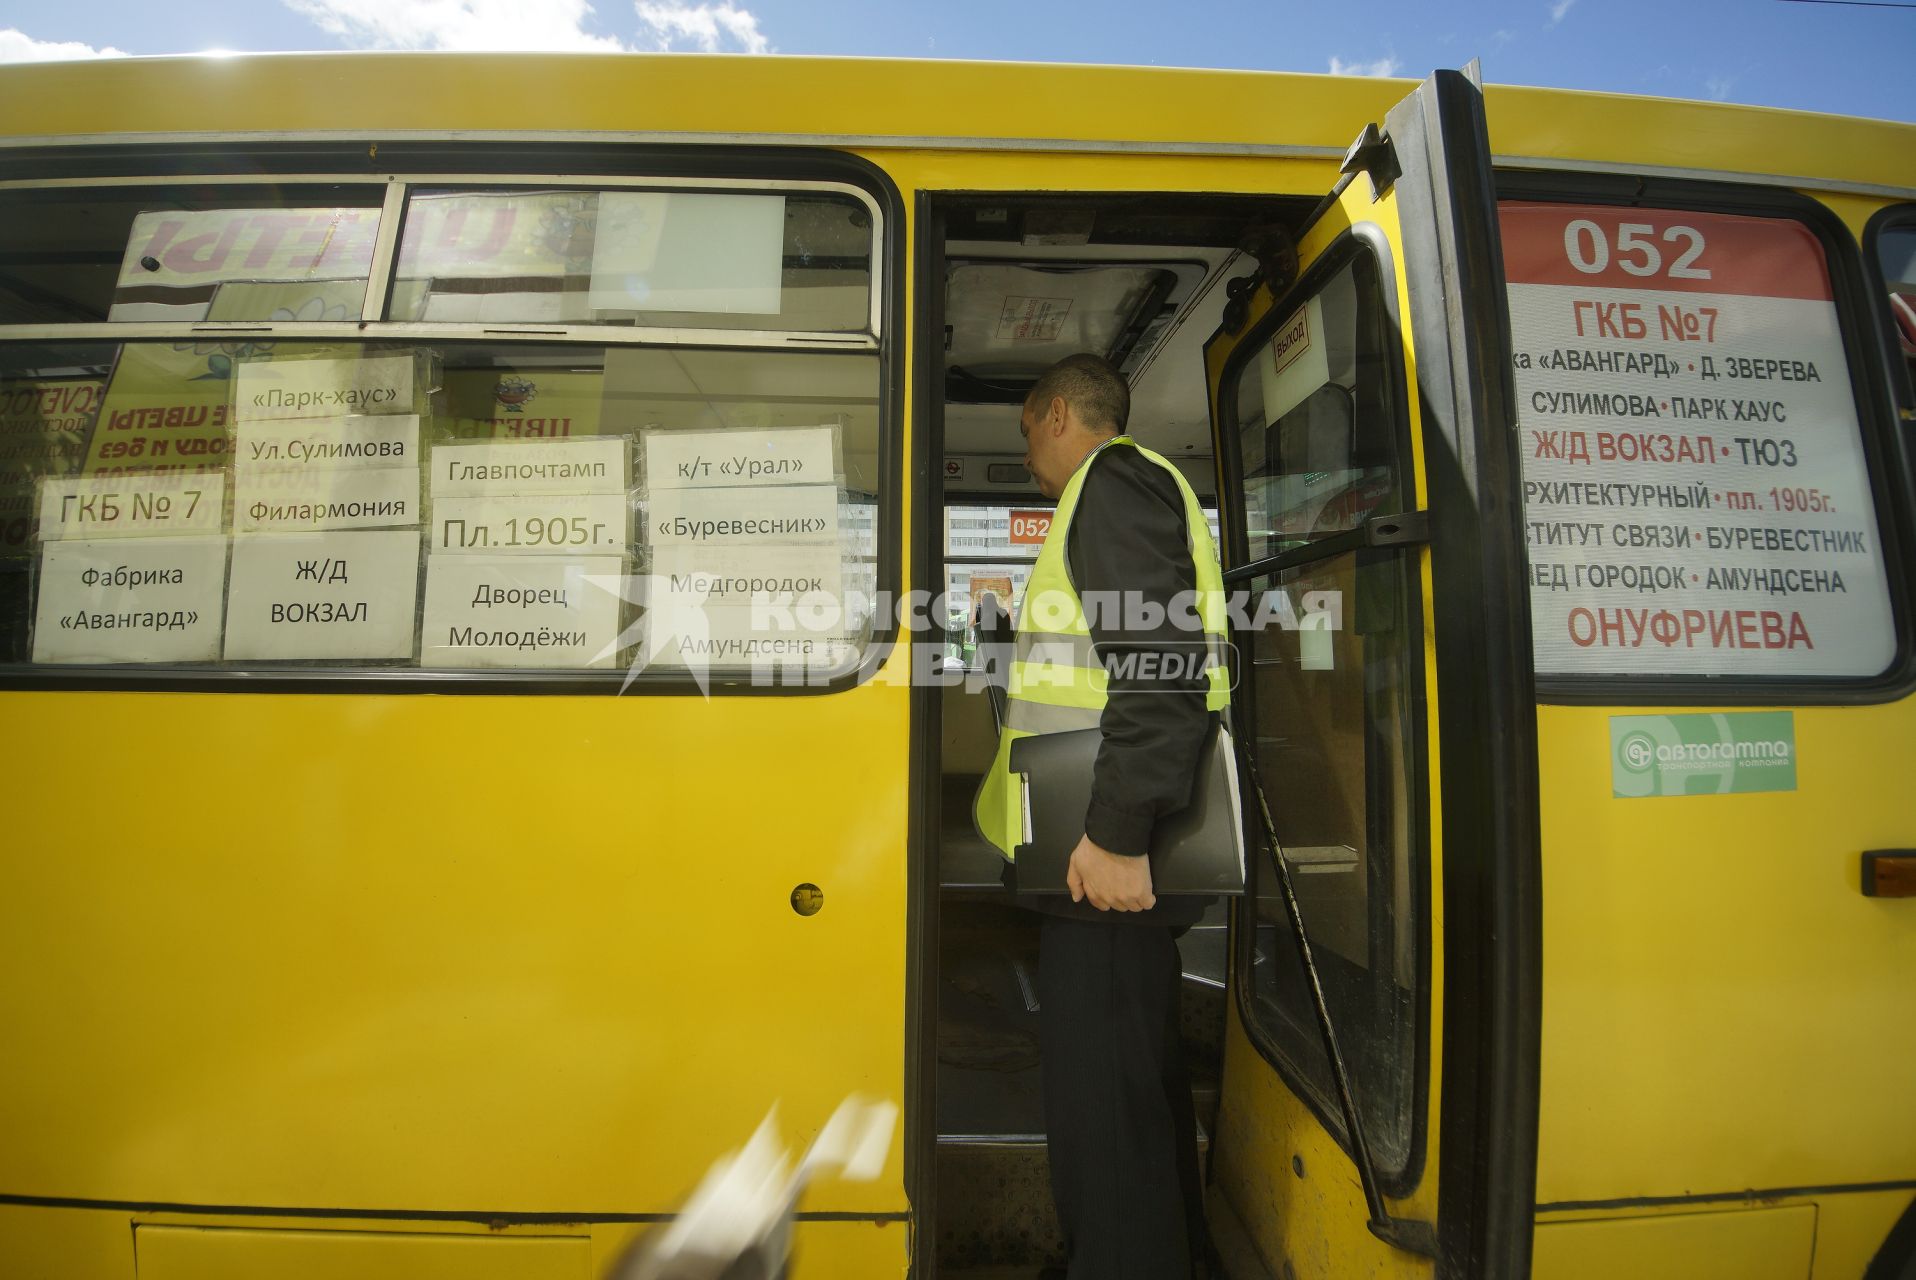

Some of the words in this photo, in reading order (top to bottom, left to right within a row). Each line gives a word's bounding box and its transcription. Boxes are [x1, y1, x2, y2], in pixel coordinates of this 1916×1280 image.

[1563, 219, 1712, 280] 052
[1572, 300, 1647, 339] ГКБ
[1658, 304, 1719, 344] №7
[1277, 321, 1305, 358] ВЫХОД
[1539, 349, 1680, 377] «АВАНГАРД»
[1701, 356, 1721, 381] Д.
[1727, 357, 1822, 383] ЗВЕРЕВА
[253, 387, 397, 409] «Парк-хаус»
[1532, 391, 1660, 418] СУЛИМОВА
[1672, 396, 1728, 421] ПАРК
[1734, 400, 1786, 423] ХАУС
[250, 439, 404, 462] Ул.Сулимова
[1532, 430, 1590, 465] Ж/Д
[1599, 432, 1717, 465] ВОКЗАЛ
[1734, 437, 1798, 466] ТЮЗ
[449, 459, 606, 481] Главпочтамп
[677, 455, 713, 478] к/т
[719, 455, 803, 478] «Урал»
[61, 494, 119, 522] ГКБ
[132, 492, 170, 520] №
[184, 491, 201, 519] 7
[249, 499, 405, 522] Филармония
[1727, 491, 1764, 511] пл.
[1770, 487, 1837, 513] 1905г.
[443, 517, 615, 548] Пл.1905г.
[658, 515, 826, 540] «Буревесник»
[1013, 518, 1050, 538] 052
[1612, 524, 1691, 548] СВЯЗИ
[1706, 527, 1867, 553] БУРЕВЕСТНИК
[81, 566, 183, 591] Фабрика
[295, 559, 347, 585] Ж/Д
[1575, 564, 1687, 593] ГОРОДОК
[1706, 568, 1847, 596] АМУНДСЕНА
[472, 585, 568, 608] Дворец
[670, 573, 822, 598] Медгородок
[60, 608, 198, 632] «Авангард»
[271, 602, 368, 624] ВОКЗАЛ
[448, 626, 587, 650] Молодёжи
[1567, 607, 1814, 650] ОНУФРИЕВА
[678, 634, 814, 658] Амундсена
